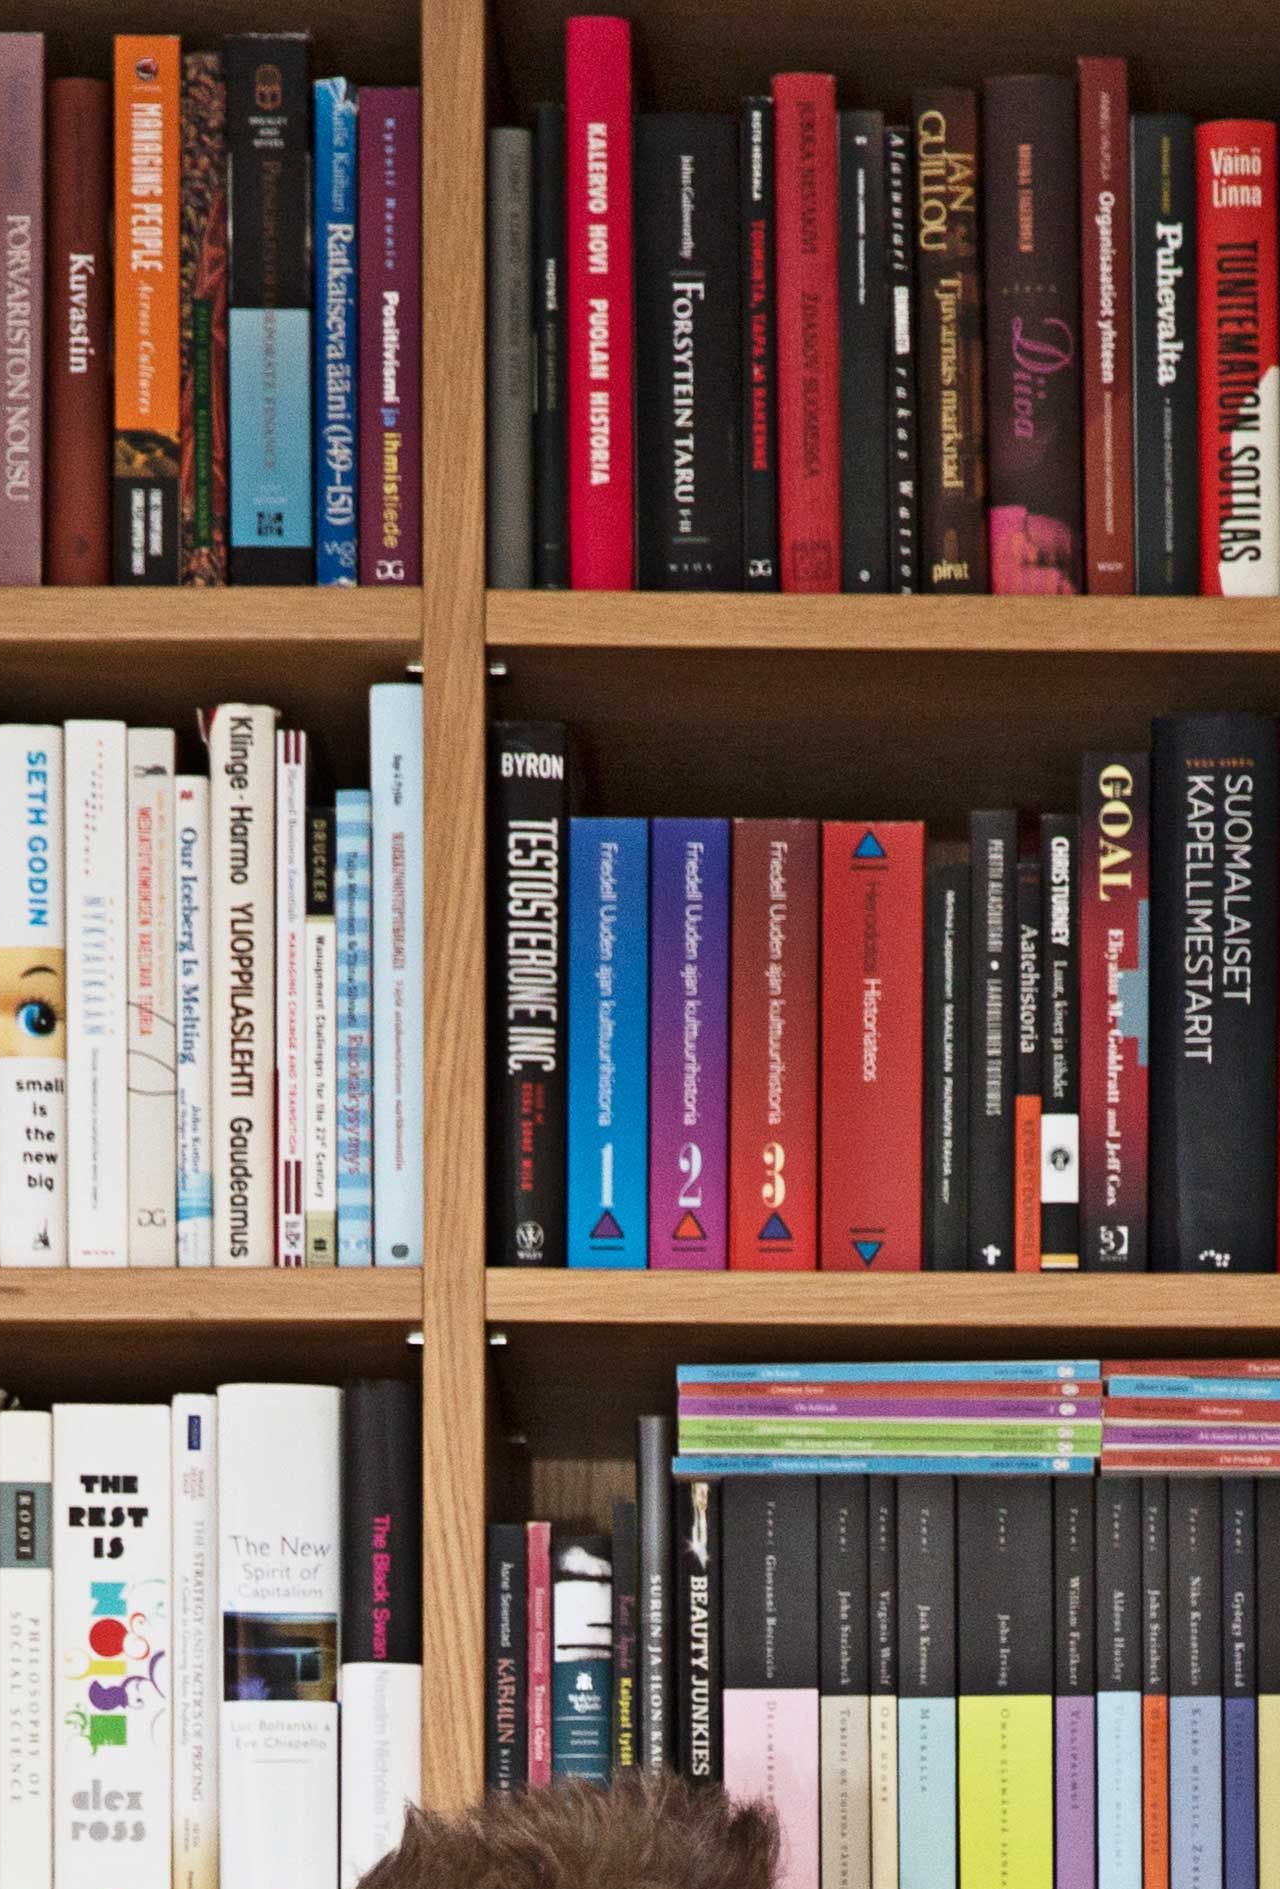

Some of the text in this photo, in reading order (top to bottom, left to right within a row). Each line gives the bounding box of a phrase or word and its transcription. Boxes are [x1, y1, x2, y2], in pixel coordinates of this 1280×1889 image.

[6, 214, 31, 501] PORVARISTON NOUSU
[69, 253, 93, 373] Kuvastin
[673, 281, 703, 502] FORSYTEIN TARU
[1157, 222, 1182, 384] Puhevalta
[1218, 240, 1260, 563] TUNTEMATON SOTILAS
[27, 751, 48, 927] SETH GODIN
[501, 752, 564, 779] BYRON
[1100, 764, 1131, 902] GOAL
[226, 716, 254, 1258] Klinge Harmo YLIOPPILASLEHTI Gaudeamus
[508, 818, 558, 1075] TESTOSTERONE INC.
[1185, 776, 1211, 1063] KAPELLIMESTARIT
[1224, 775, 1250, 1004] SUOMALAISET
[373, 1515, 390, 1658] The Black Swan
[690, 1576, 709, 1774] BEAUTY JUNKIES
